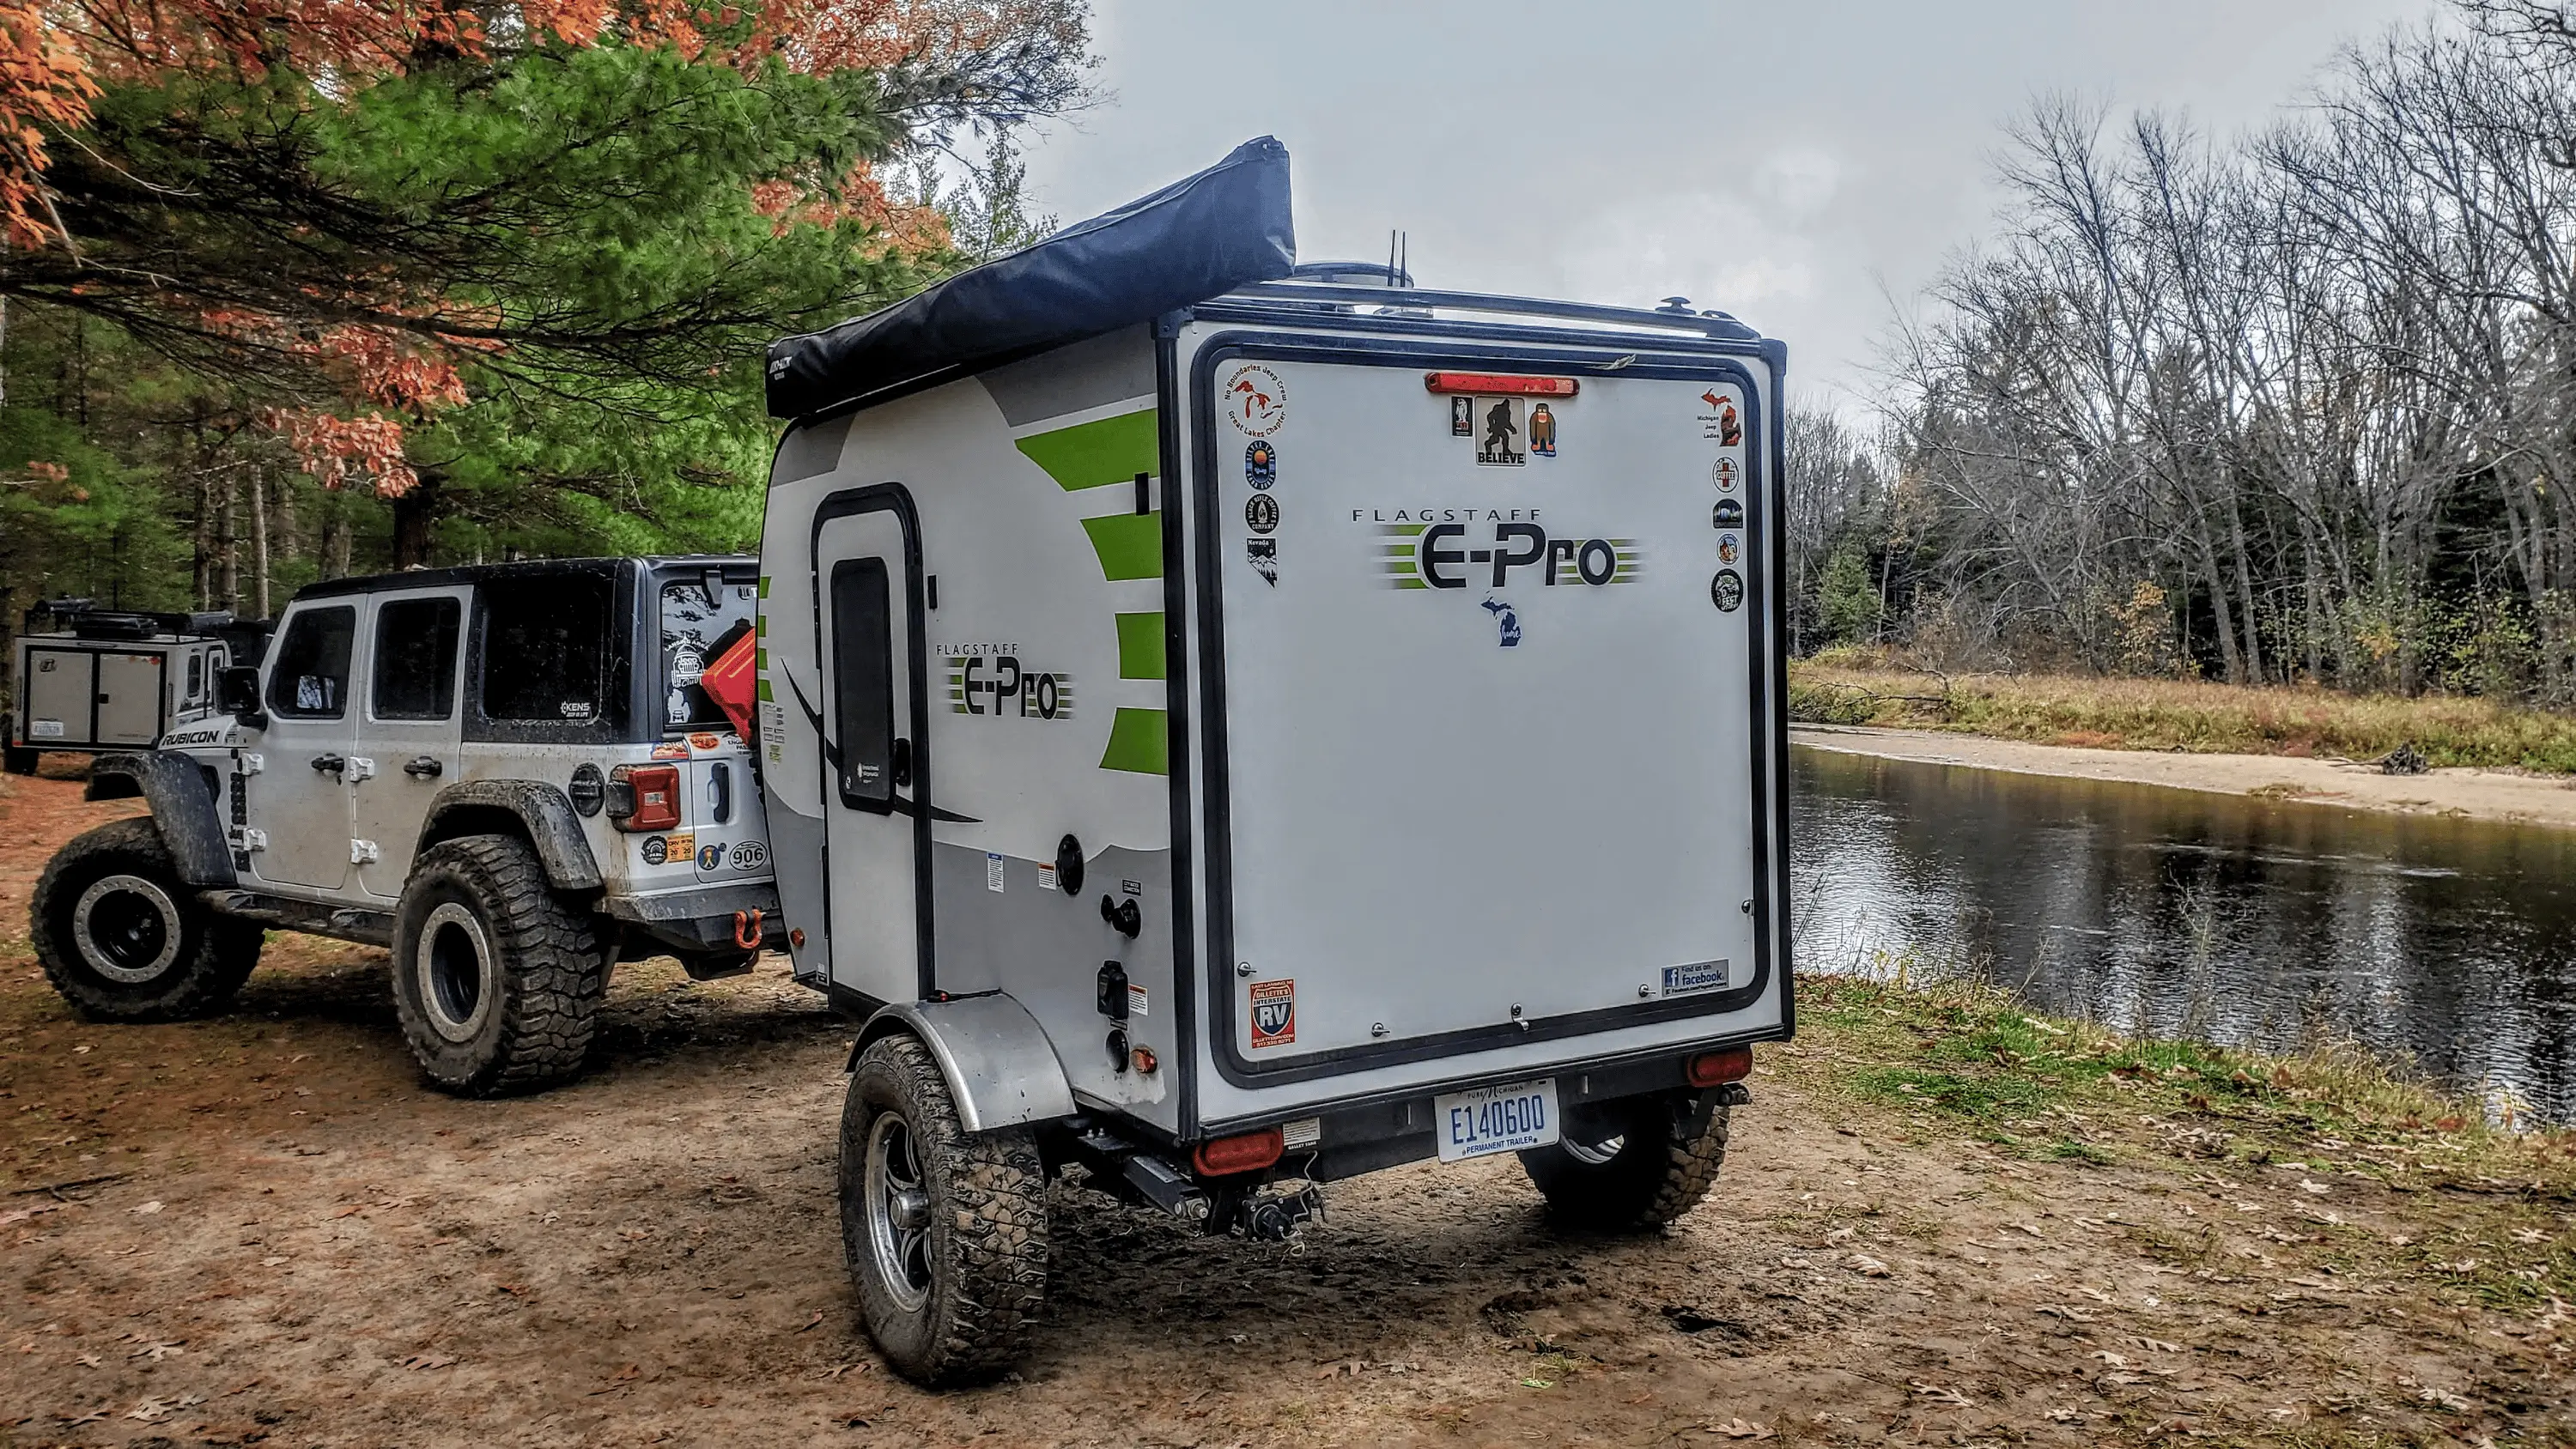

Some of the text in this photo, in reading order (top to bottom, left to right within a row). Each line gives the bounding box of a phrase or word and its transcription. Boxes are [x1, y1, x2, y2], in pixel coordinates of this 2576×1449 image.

[1224, 364, 1287, 401] No Boundaries Jeep Crew
[1228, 410, 1287, 438] Great Lakes Chapter
[1478, 452, 1524, 464] BELIEVE
[1352, 509, 1541, 522] FLAGSTAFF
[1422, 523, 1616, 589] E-Pro
[937, 644, 1018, 655] FLAGSTAFF
[964, 656, 1059, 720] E-Pro
[161, 731, 220, 746] RUBICON
[733, 848, 763, 864] 906
[1681, 970, 1722, 985] facebook
[1254, 996, 1291, 1006] INTERSTATE
[1256, 988, 1289, 998] GILLETTE'S
[1259, 1003, 1288, 1027] RV
[1450, 1094, 1546, 1145] E140600
[1466, 1135, 1534, 1155] PERMANENT TRAILER
